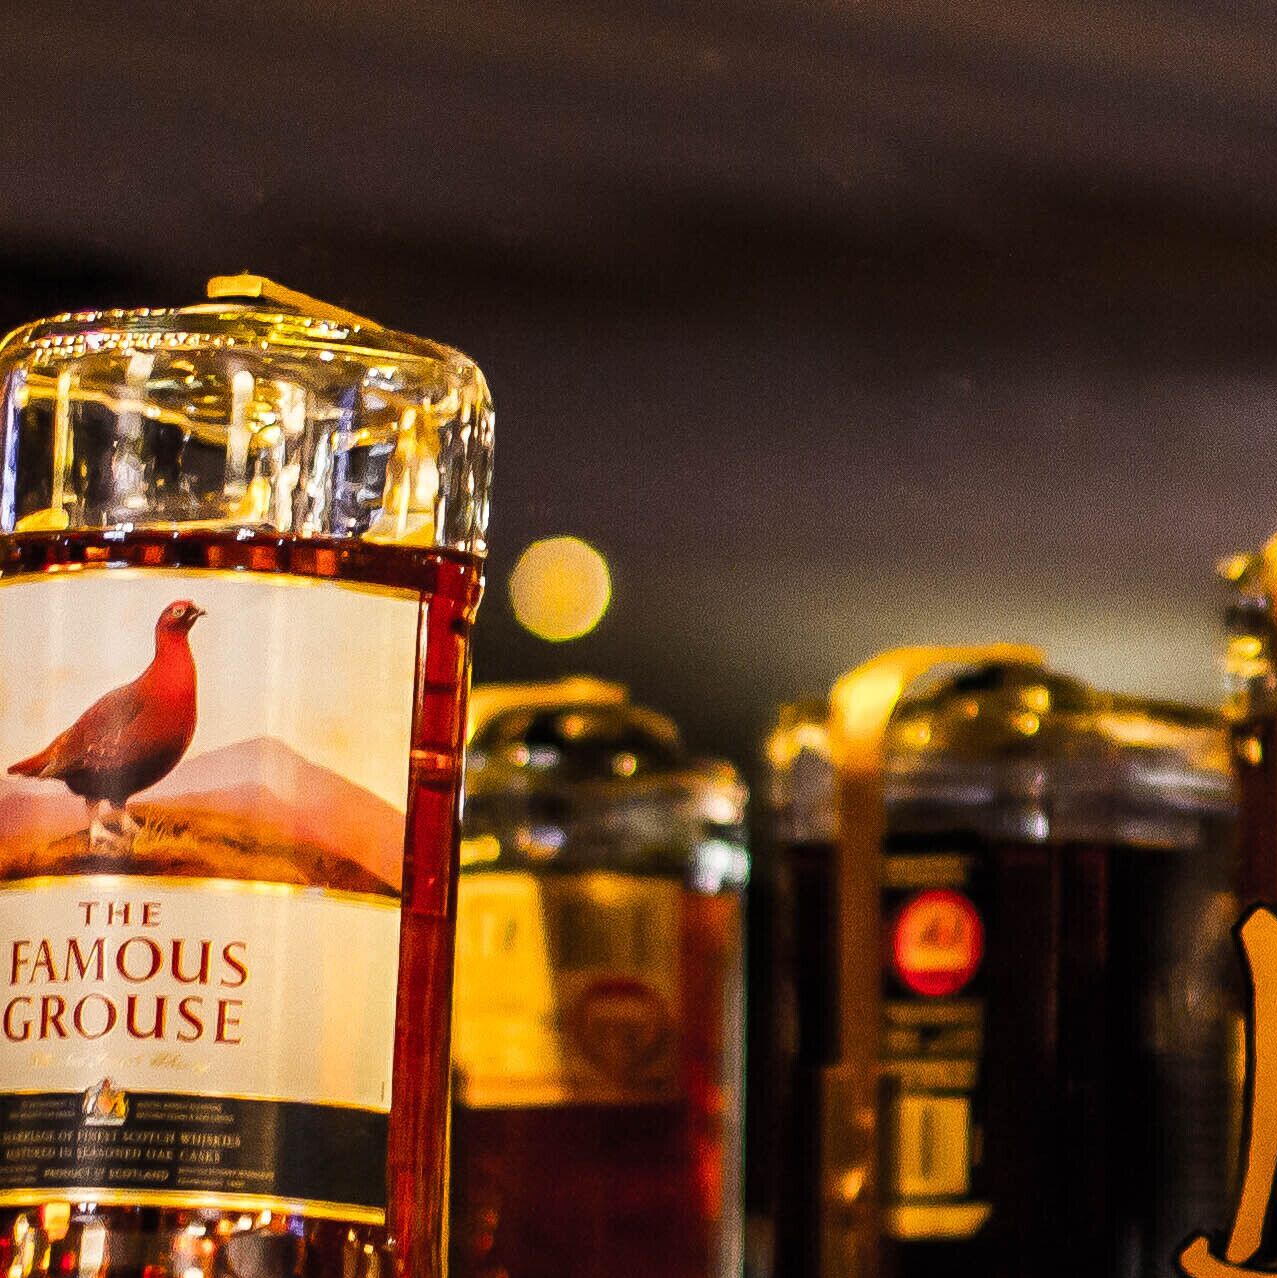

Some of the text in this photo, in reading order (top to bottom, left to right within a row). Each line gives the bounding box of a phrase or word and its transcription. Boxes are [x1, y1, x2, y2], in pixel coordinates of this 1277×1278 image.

[79, 902, 161, 927] THE
[10, 936, 250, 987] FAMOUS
[3, 993, 243, 1044] GROUSE
